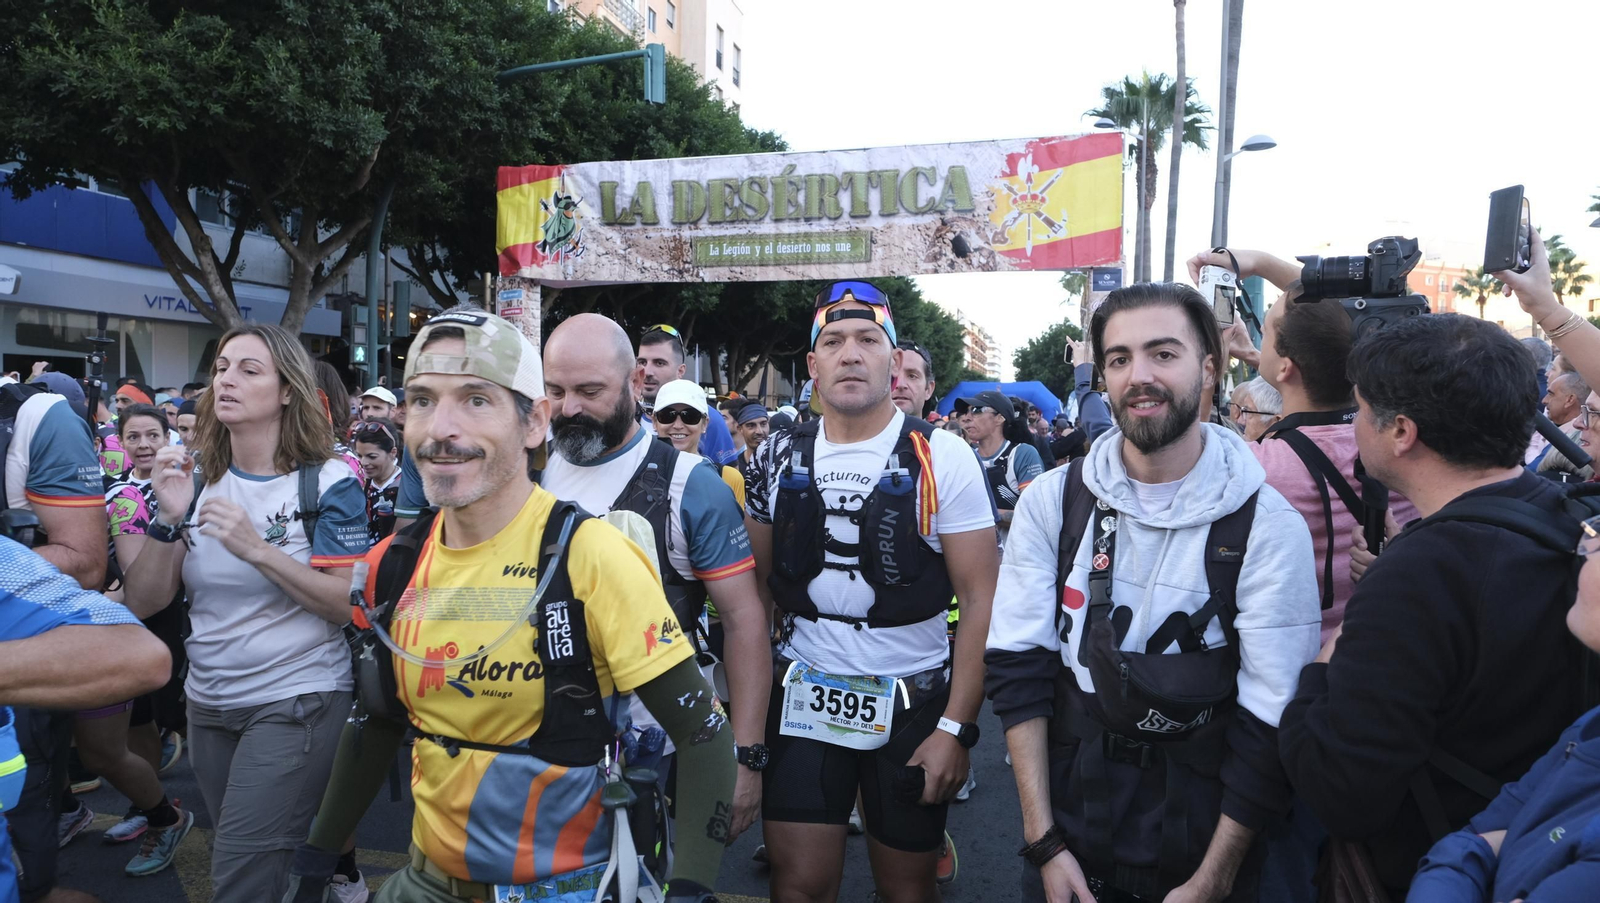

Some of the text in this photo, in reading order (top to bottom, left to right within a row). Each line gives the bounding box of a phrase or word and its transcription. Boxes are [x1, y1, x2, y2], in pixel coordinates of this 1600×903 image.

[599, 163, 976, 226] LA DESÉRTICA
[709, 241, 852, 257] La Legión y el desierto nos une
[877, 508, 900, 587] KIPRUN
[545, 600, 568, 612] grupo
[481, 689, 513, 700] Málaga
[809, 684, 877, 723] 3595
[784, 720, 808, 731] asisa
